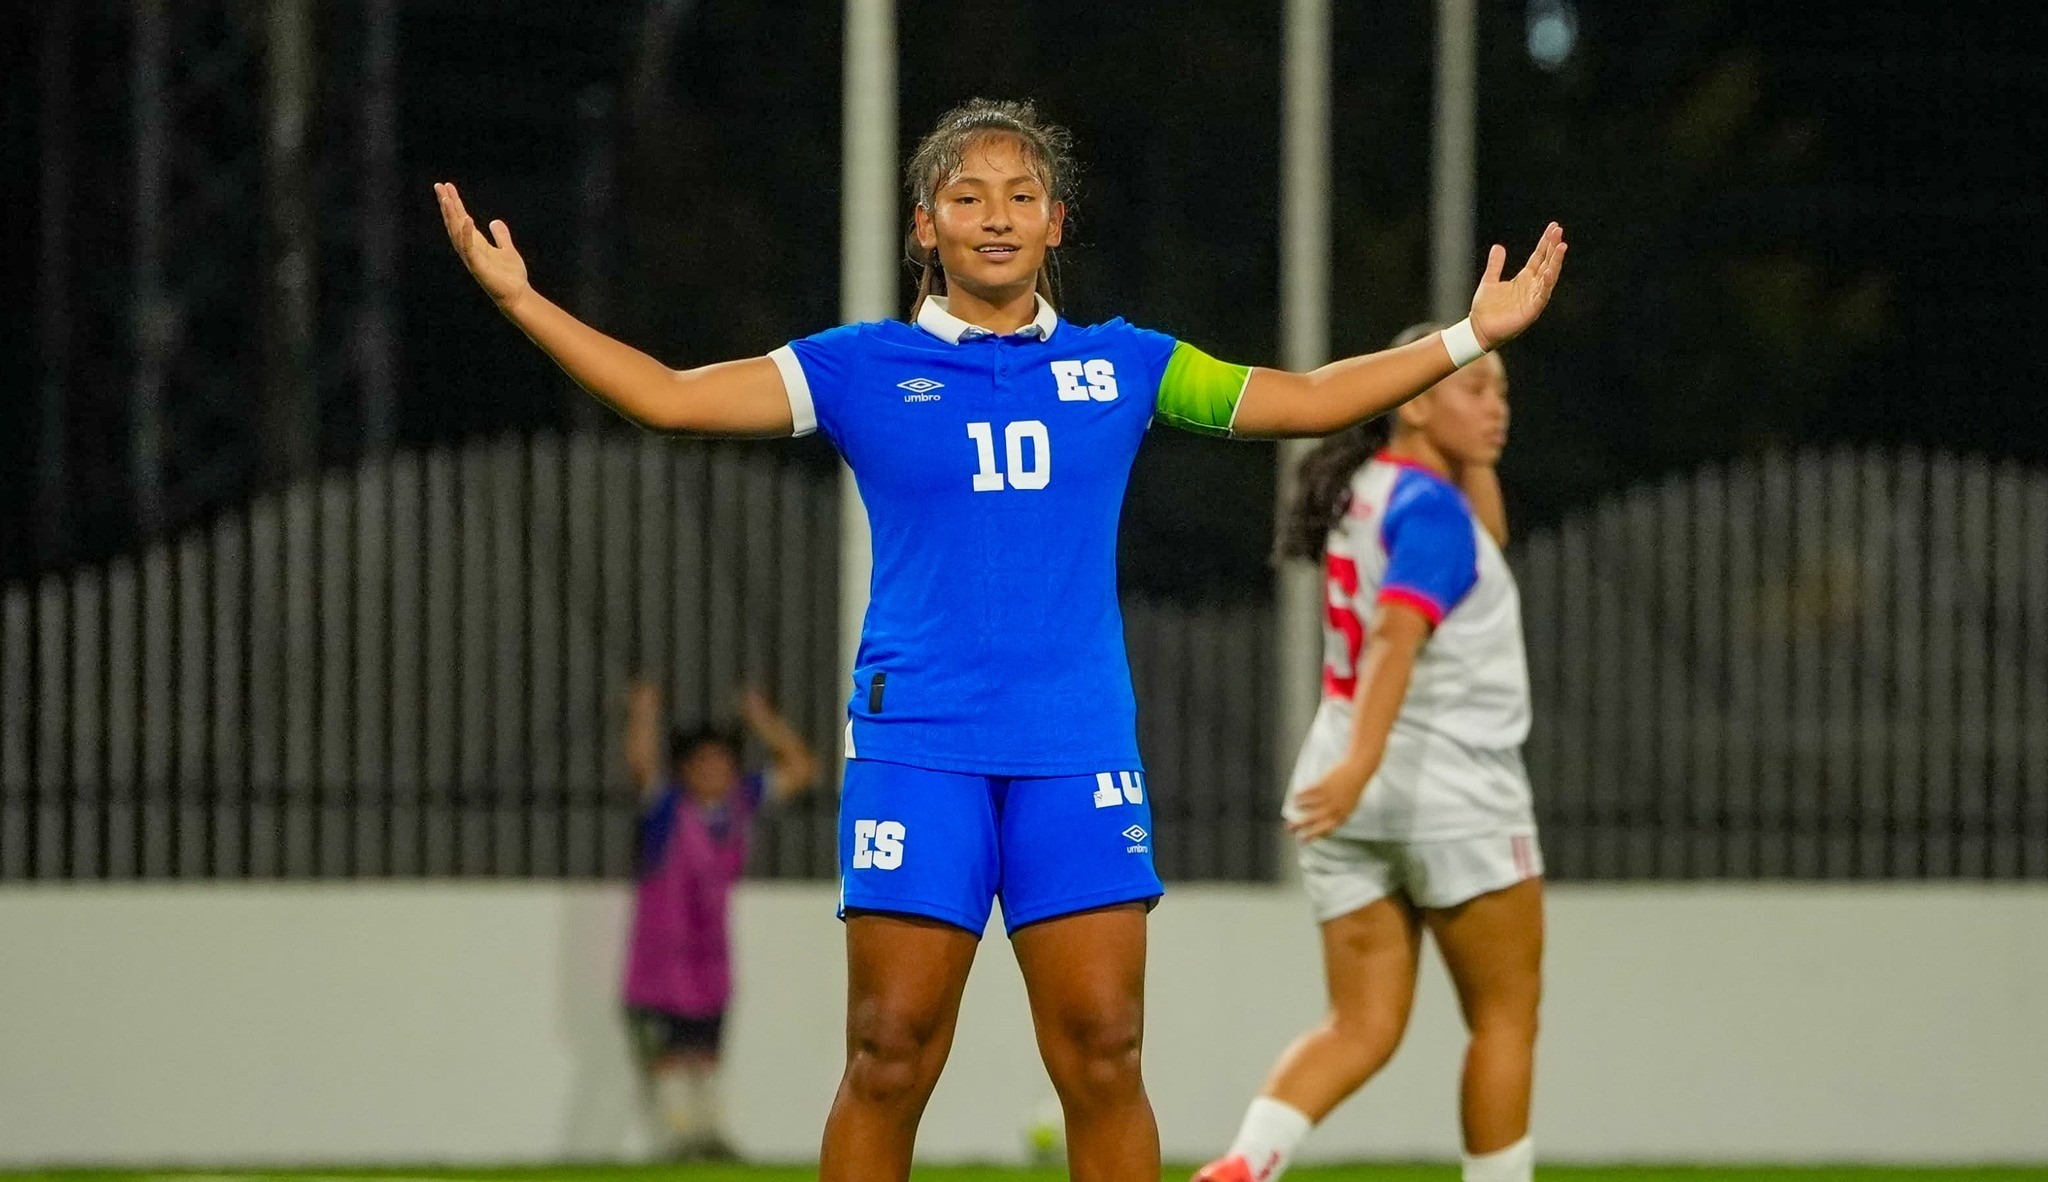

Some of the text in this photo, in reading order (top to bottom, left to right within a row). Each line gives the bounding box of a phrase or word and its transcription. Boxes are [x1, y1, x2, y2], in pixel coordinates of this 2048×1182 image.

[904, 392, 941, 403] umbro
[1051, 359, 1119, 402] ES
[966, 420, 1051, 492] 10
[852, 819, 906, 871] ES
